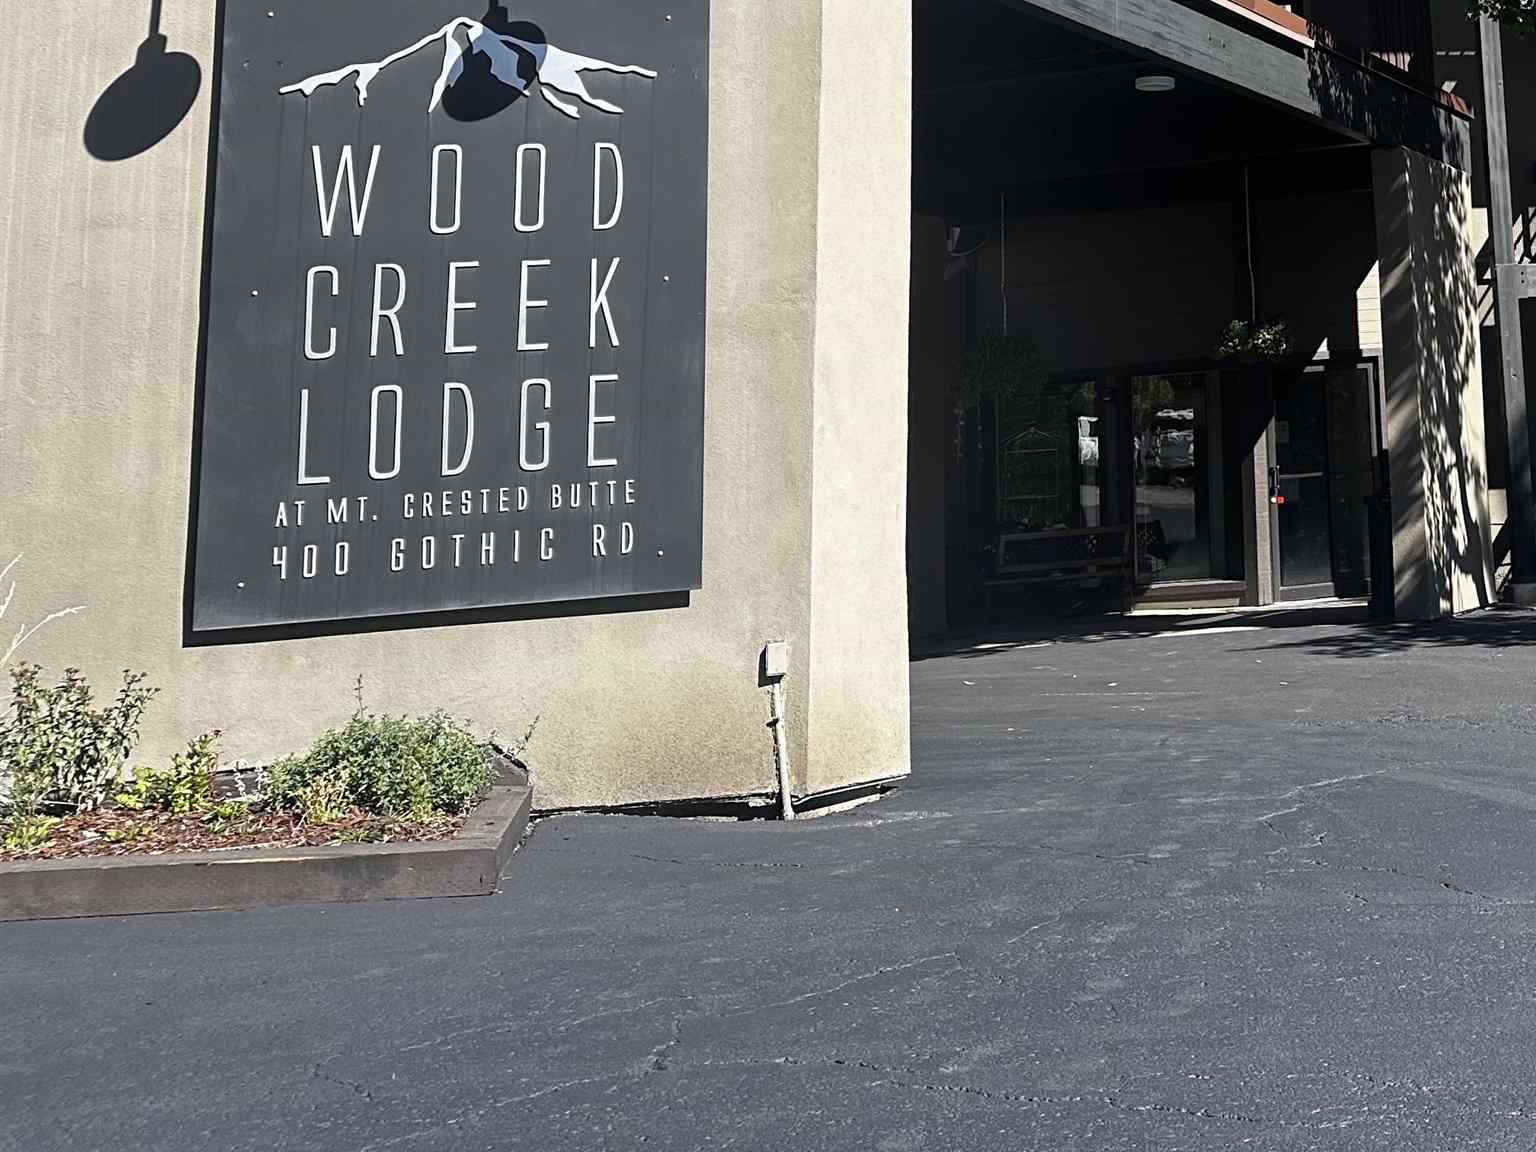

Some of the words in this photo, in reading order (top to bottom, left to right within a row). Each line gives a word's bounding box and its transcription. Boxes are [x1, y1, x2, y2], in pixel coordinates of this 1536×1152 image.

[311, 142, 624, 237] WOOD
[304, 257, 621, 360] CREEK
[297, 374, 619, 485] LODGE
[272, 542, 350, 580] 400
[391, 527, 554, 571] GOTHIC
[592, 522, 634, 557] RD
[274, 500, 306, 528] AT
[327, 496, 378, 524] MT.
[404, 486, 529, 518] CRESTED
[551, 479, 636, 509] BUTTE
